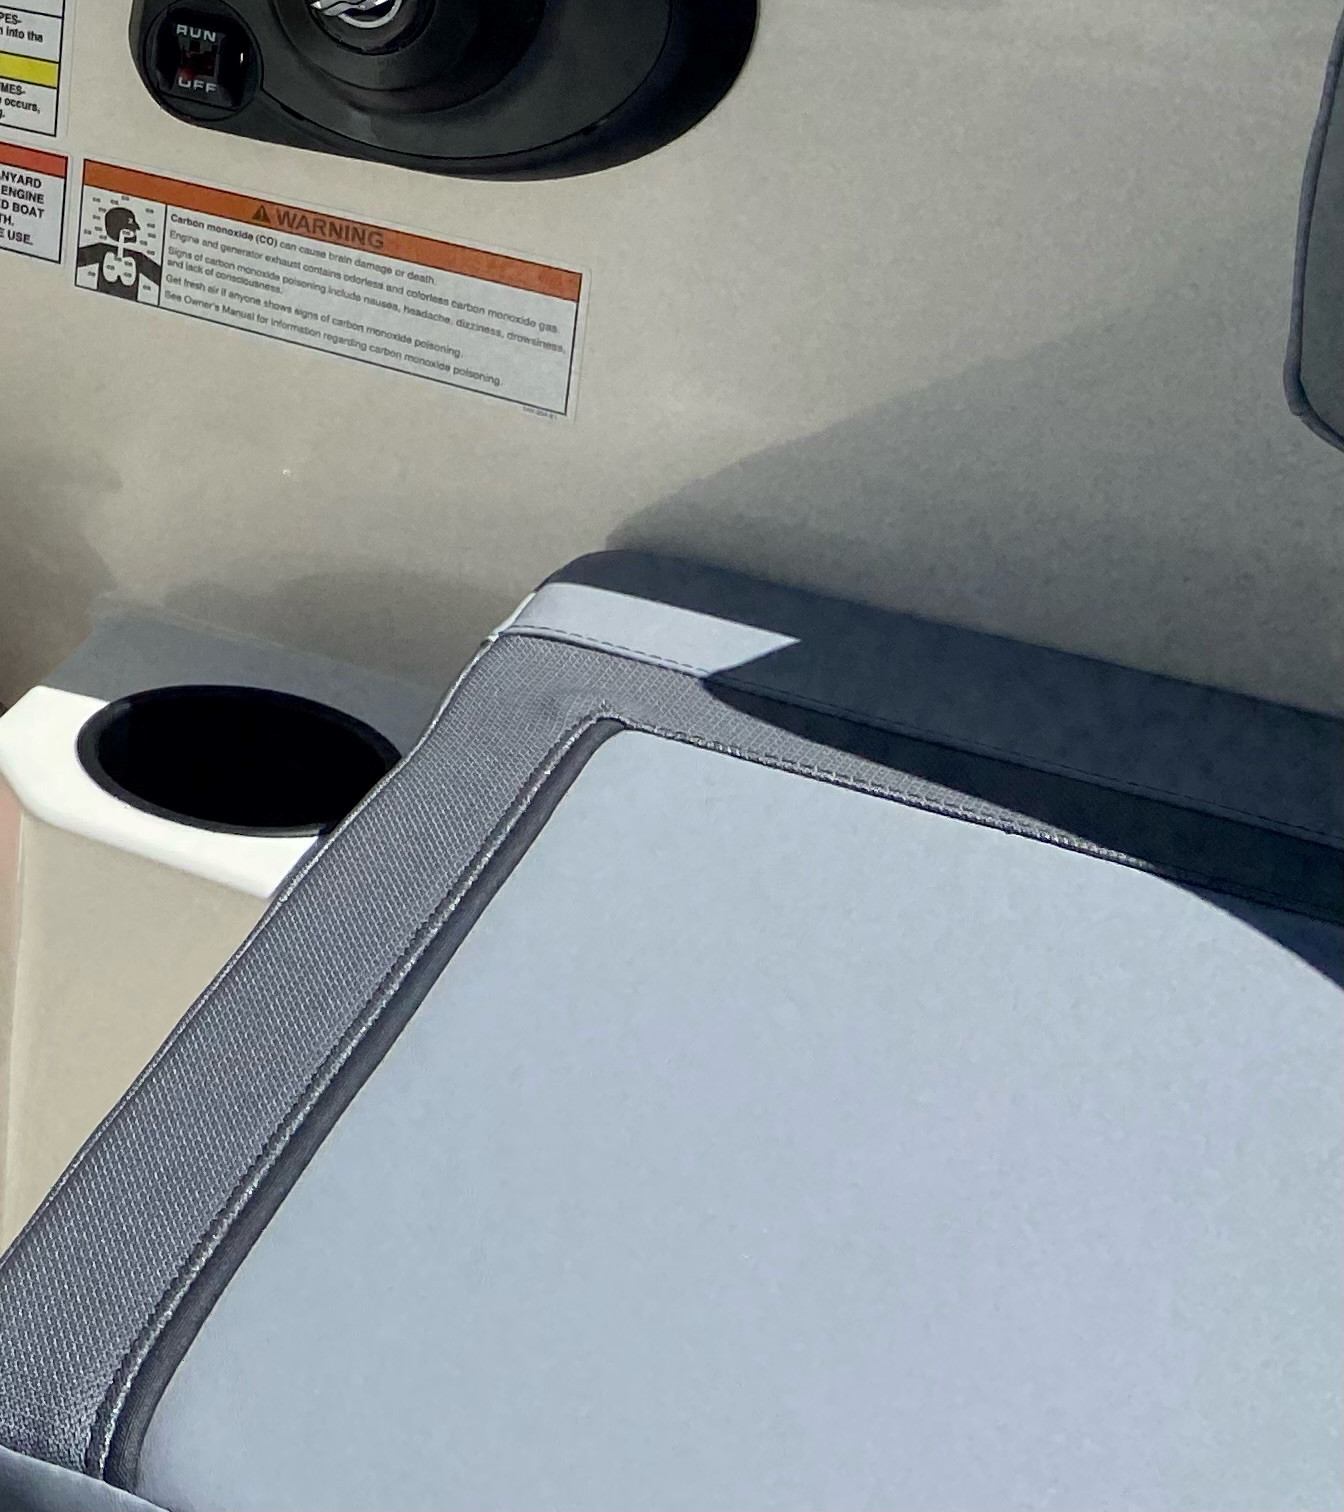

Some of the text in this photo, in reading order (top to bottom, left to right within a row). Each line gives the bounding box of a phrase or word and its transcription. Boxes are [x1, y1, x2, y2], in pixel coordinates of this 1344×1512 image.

[176, 23, 217, 43] RUN
[178, 76, 218, 93] OFF
[0, 184, 44, 205] ENGINE
[11, 201, 45, 219] BOAT
[276, 208, 384, 250] WARNING
